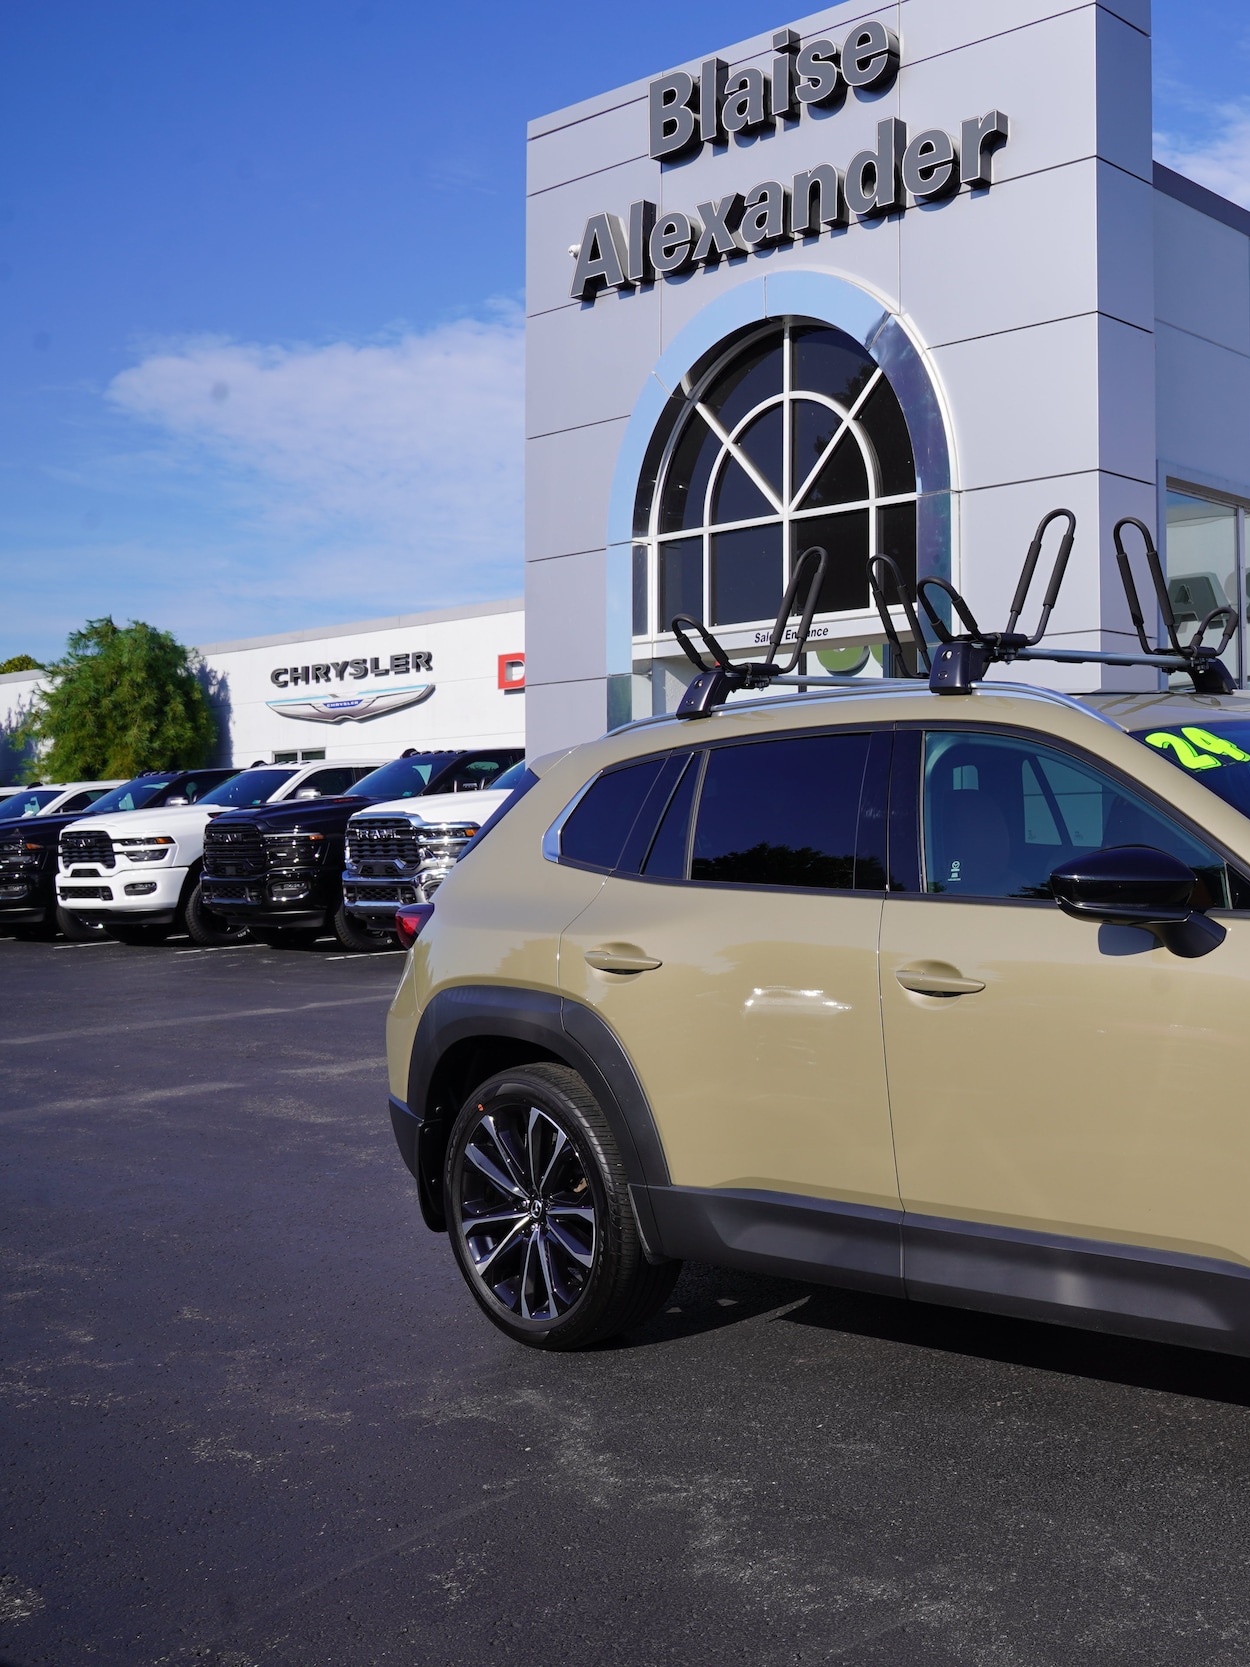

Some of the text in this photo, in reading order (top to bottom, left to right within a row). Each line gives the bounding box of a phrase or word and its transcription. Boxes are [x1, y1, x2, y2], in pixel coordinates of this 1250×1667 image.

[648, 19, 900, 162] Blaise
[568, 108, 1008, 299] Alexander
[754, 627, 829, 644] Sal Ennce
[270, 651, 433, 688] CHRYSLER
[326, 700, 359, 708] CHRYSLER
[1145, 727, 1250, 769] 24
